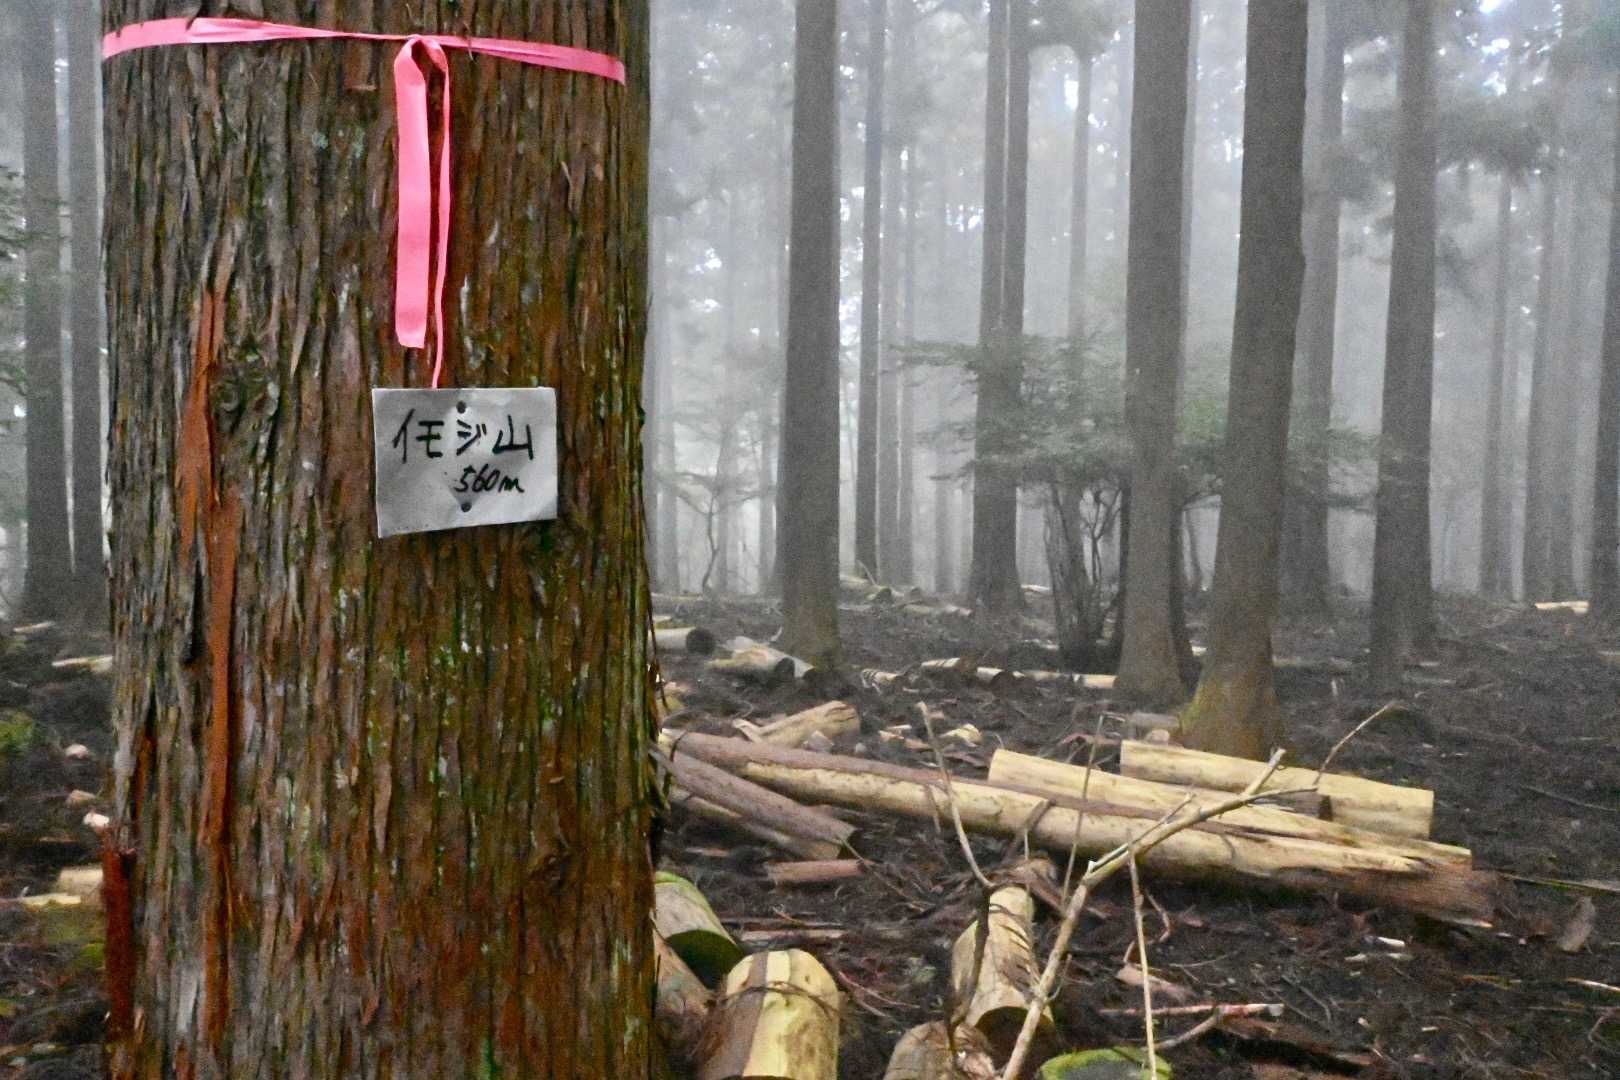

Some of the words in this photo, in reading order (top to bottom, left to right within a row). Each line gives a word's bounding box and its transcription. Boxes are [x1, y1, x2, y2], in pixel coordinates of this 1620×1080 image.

[392, 408, 534, 464] イモジ山
[454, 463, 525, 493] 560m
